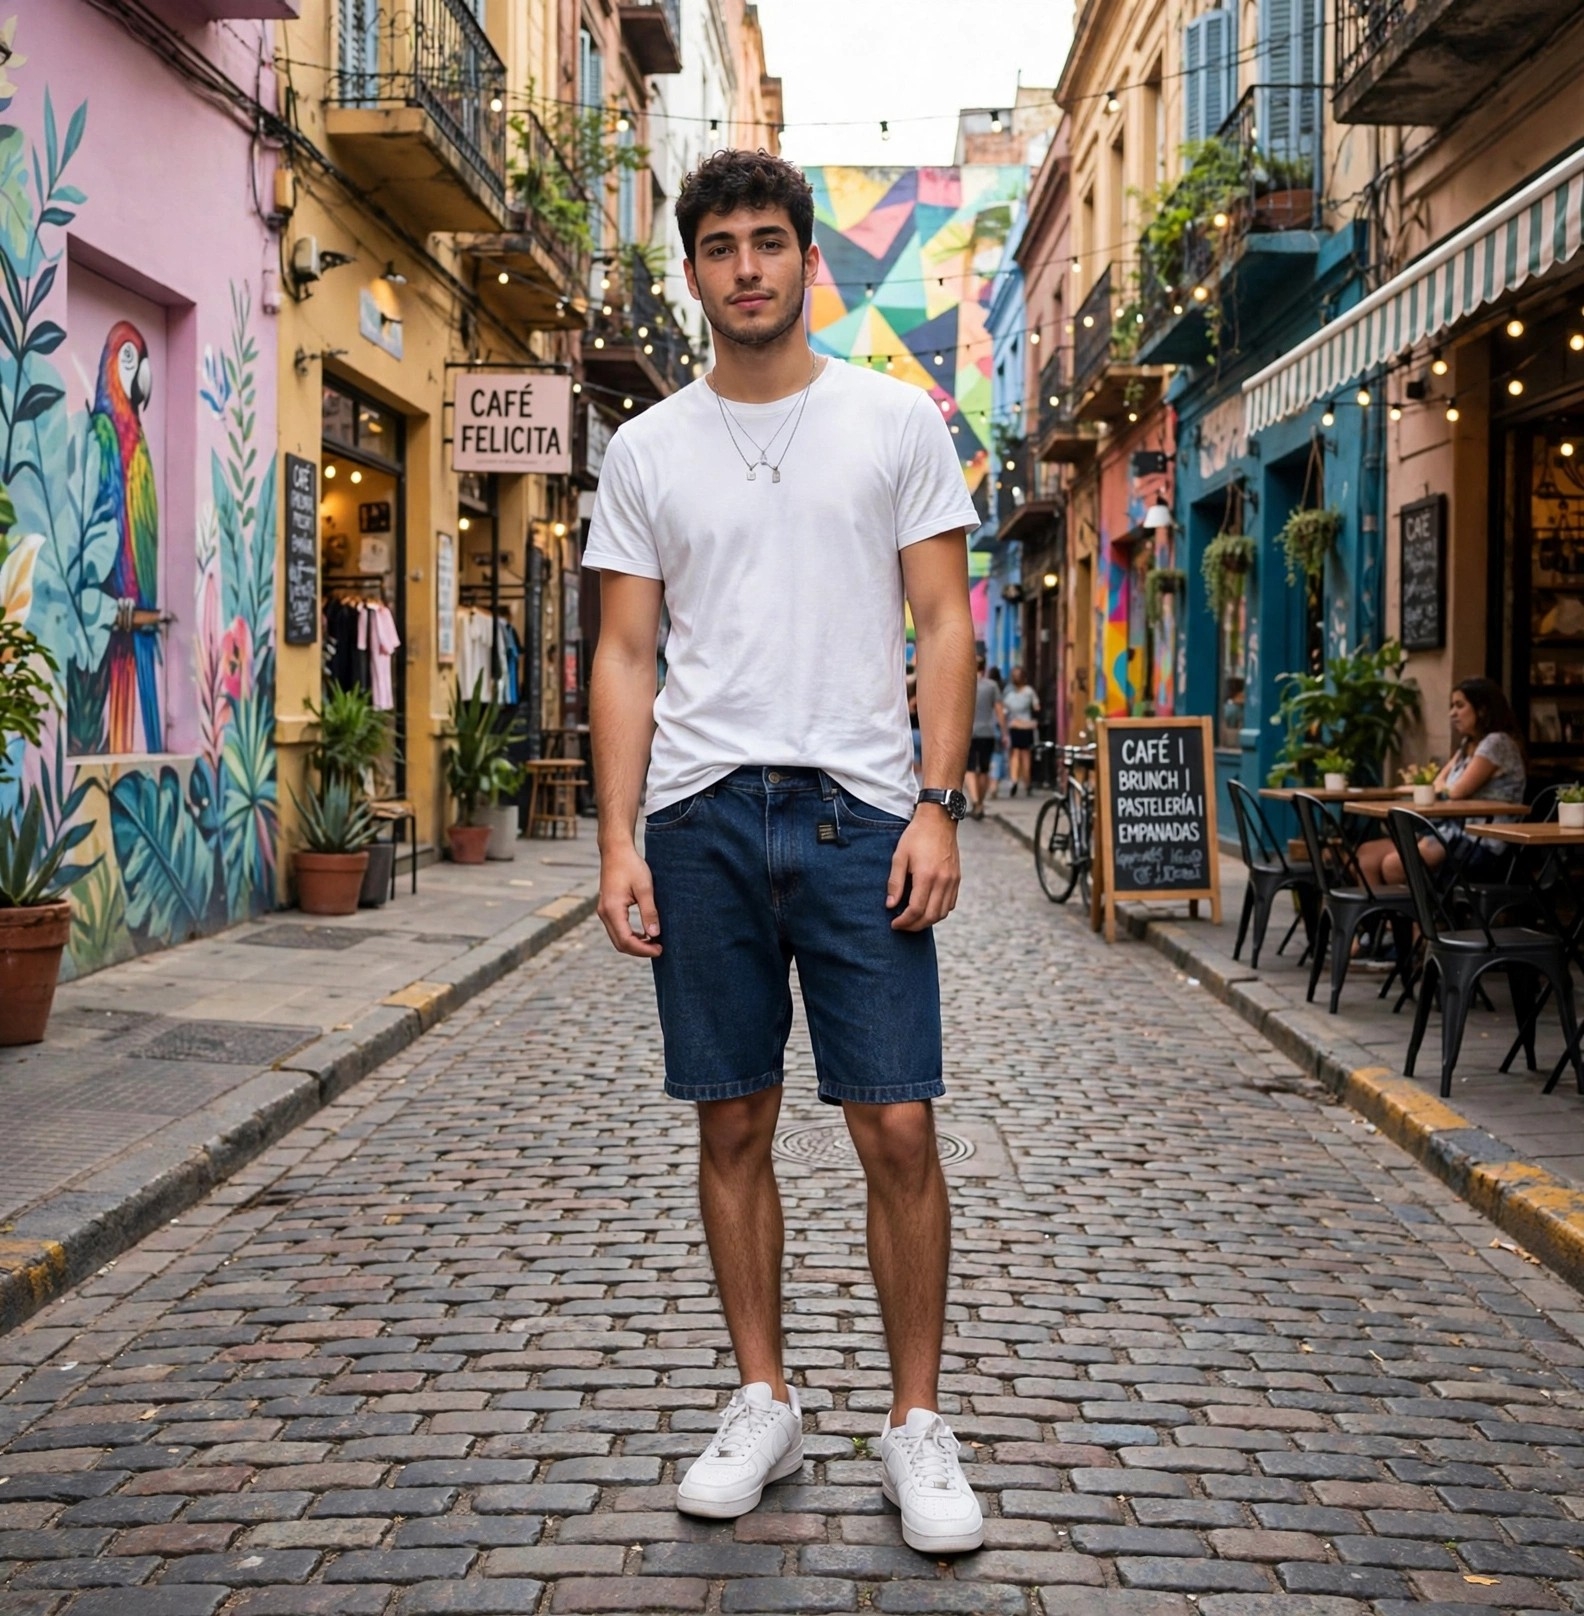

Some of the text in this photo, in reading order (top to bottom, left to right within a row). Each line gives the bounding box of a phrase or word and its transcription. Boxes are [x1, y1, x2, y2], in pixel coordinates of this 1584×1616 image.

[470, 383, 533, 418] CAFÉ
[461, 425, 561, 455] FELICITA
[1121, 733, 1170, 765] CAFÉ
[1118, 769, 1179, 791] BRUNCH
[1117, 792, 1195, 818] PASTELERÍA
[1118, 822, 1200, 844] EMPANADAS
